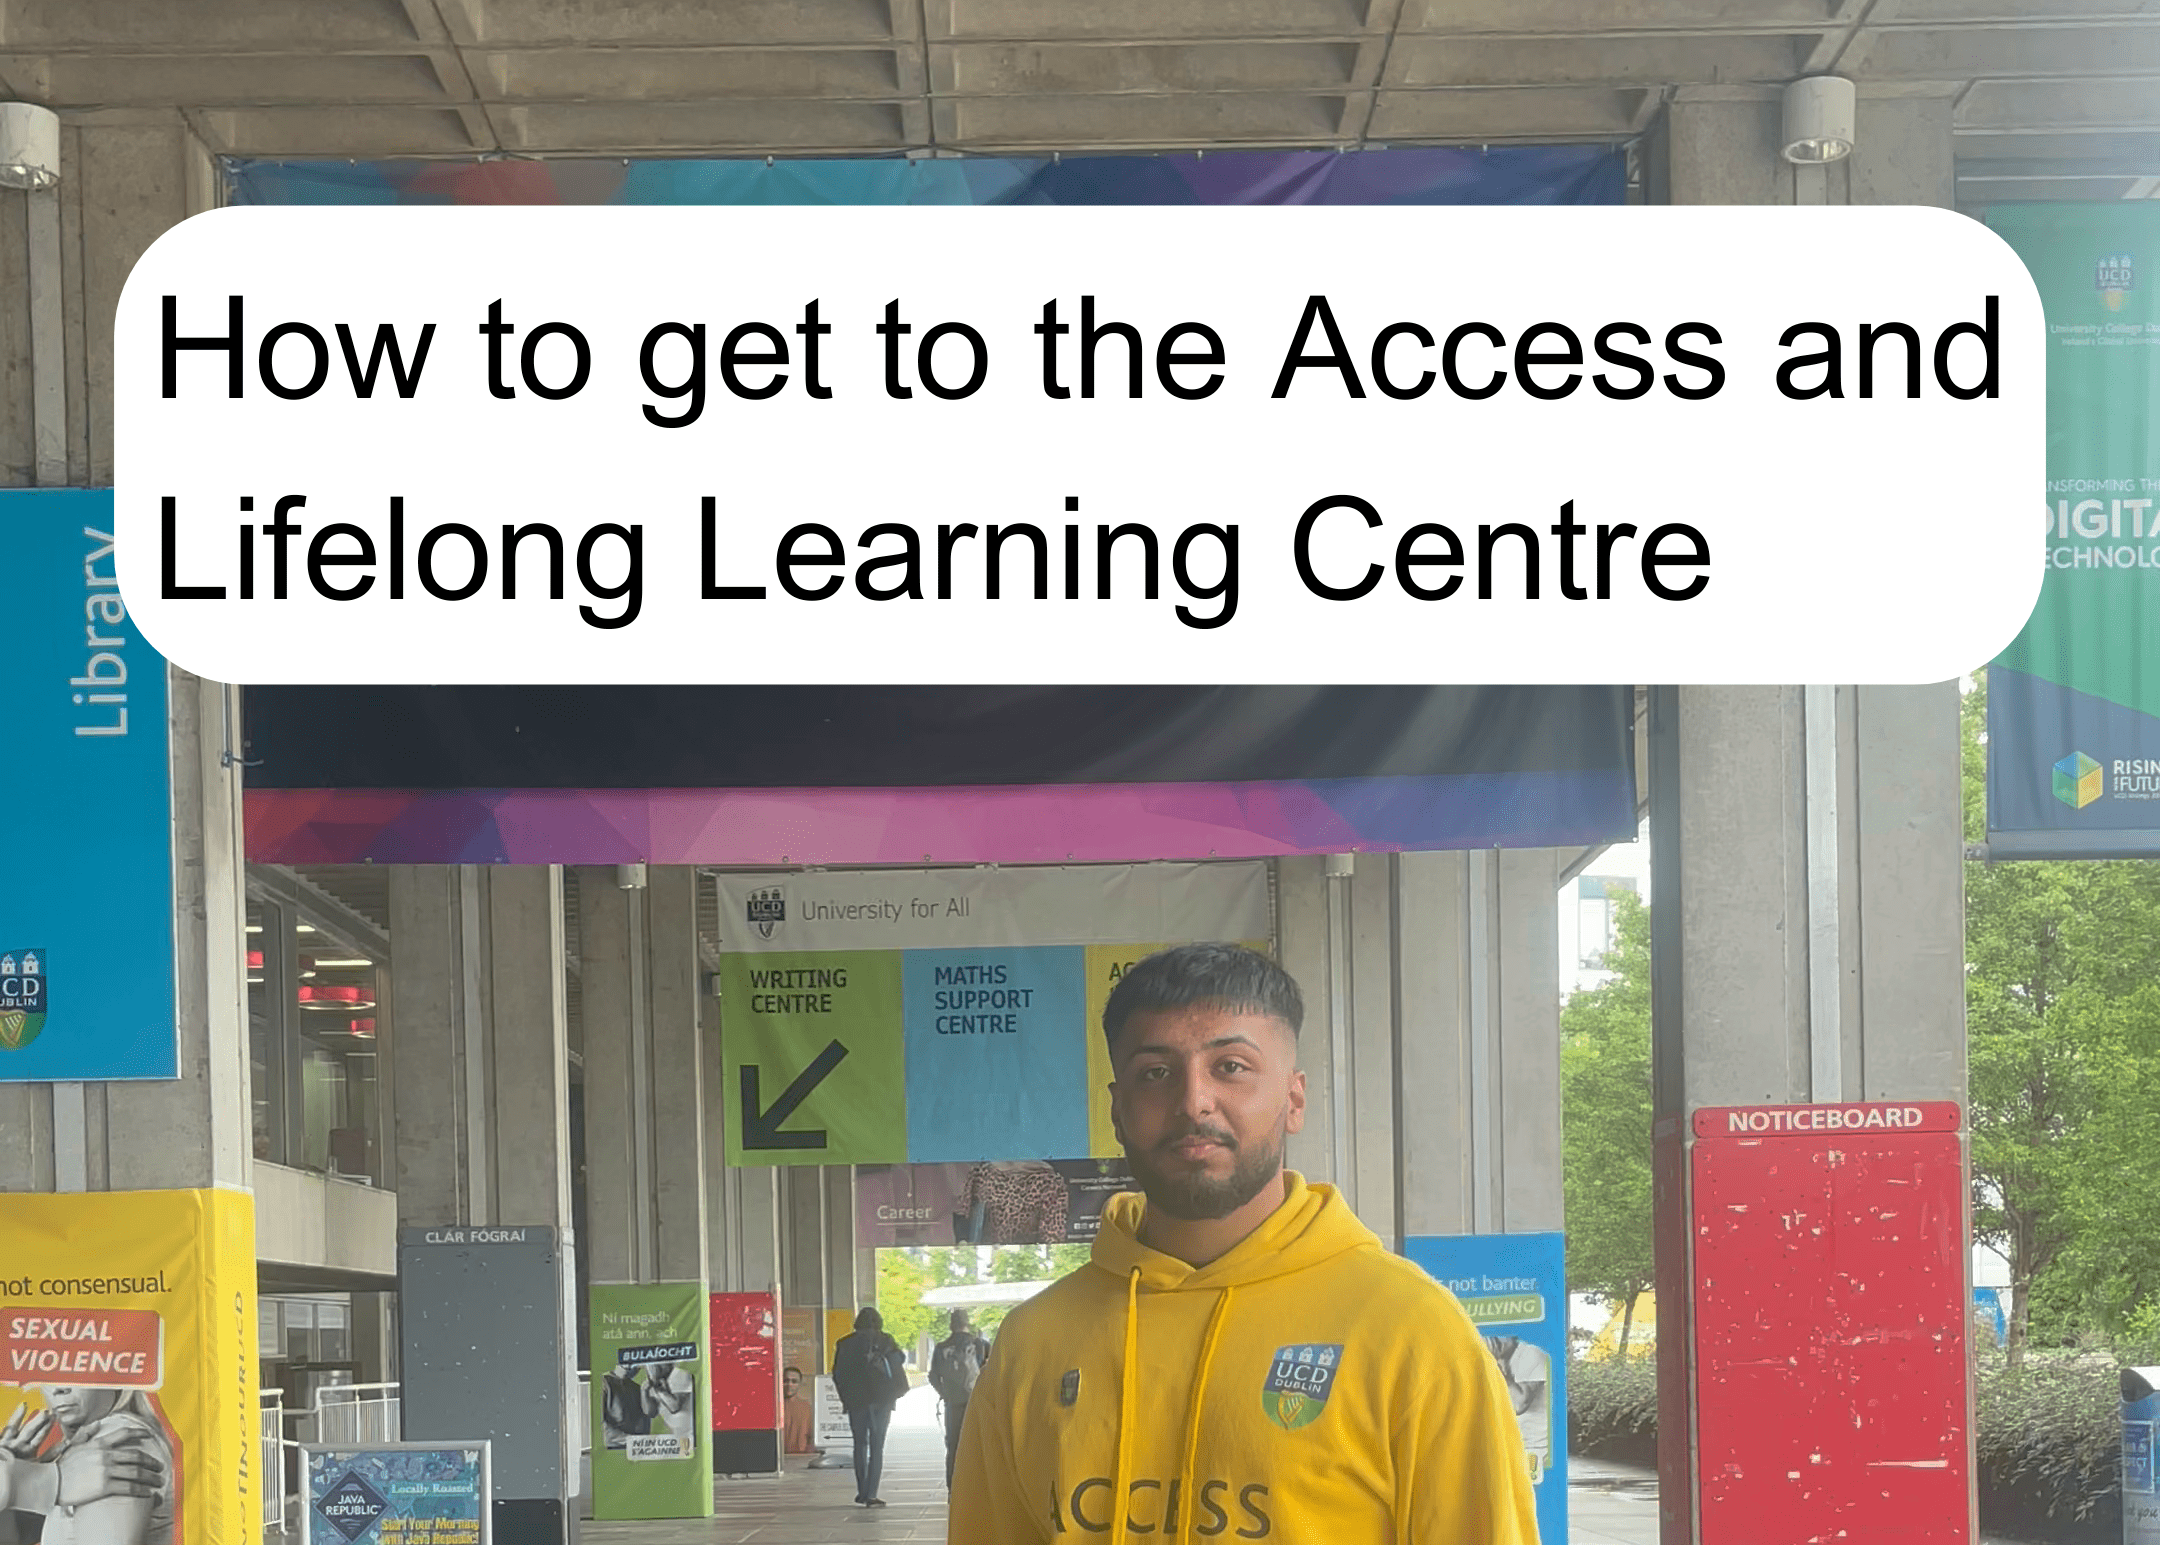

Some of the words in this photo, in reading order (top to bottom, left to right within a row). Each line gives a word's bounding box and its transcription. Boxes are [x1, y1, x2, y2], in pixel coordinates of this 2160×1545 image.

[2046, 479, 2136, 492] NSFORMING
[70, 526, 128, 735] Library
[751, 901, 782, 911] UCD
[802, 899, 903, 923] University
[911, 898, 939, 919] for
[946, 897, 970, 918] All
[750, 968, 847, 989] WRITING
[934, 965, 1008, 985] MATHS
[0, 977, 40, 997] CD
[751, 994, 832, 1014] CENTRE
[934, 989, 1033, 1010] SUPPORT
[935, 1014, 1017, 1034] CENTRE
[1728, 1107, 1923, 1132] NOTICEBOARD
[876, 1204, 932, 1219] Career
[40, 1270, 172, 1296] consensual.
[1449, 1277, 1478, 1292] not
[1465, 1299, 1536, 1317] ULLYING
[9, 1317, 113, 1342] SEXUAL
[11, 1348, 147, 1374] VIOLENCE
[622, 1345, 693, 1361] BULAÍOCHT
[1276, 1361, 1328, 1384] UCD
[1274, 1378, 1322, 1394] DUBLIN
[391, 1482, 429, 1496] Locally
[337, 1494, 366, 1505] JAVA
[325, 1505, 379, 1516] REPUBLIC
